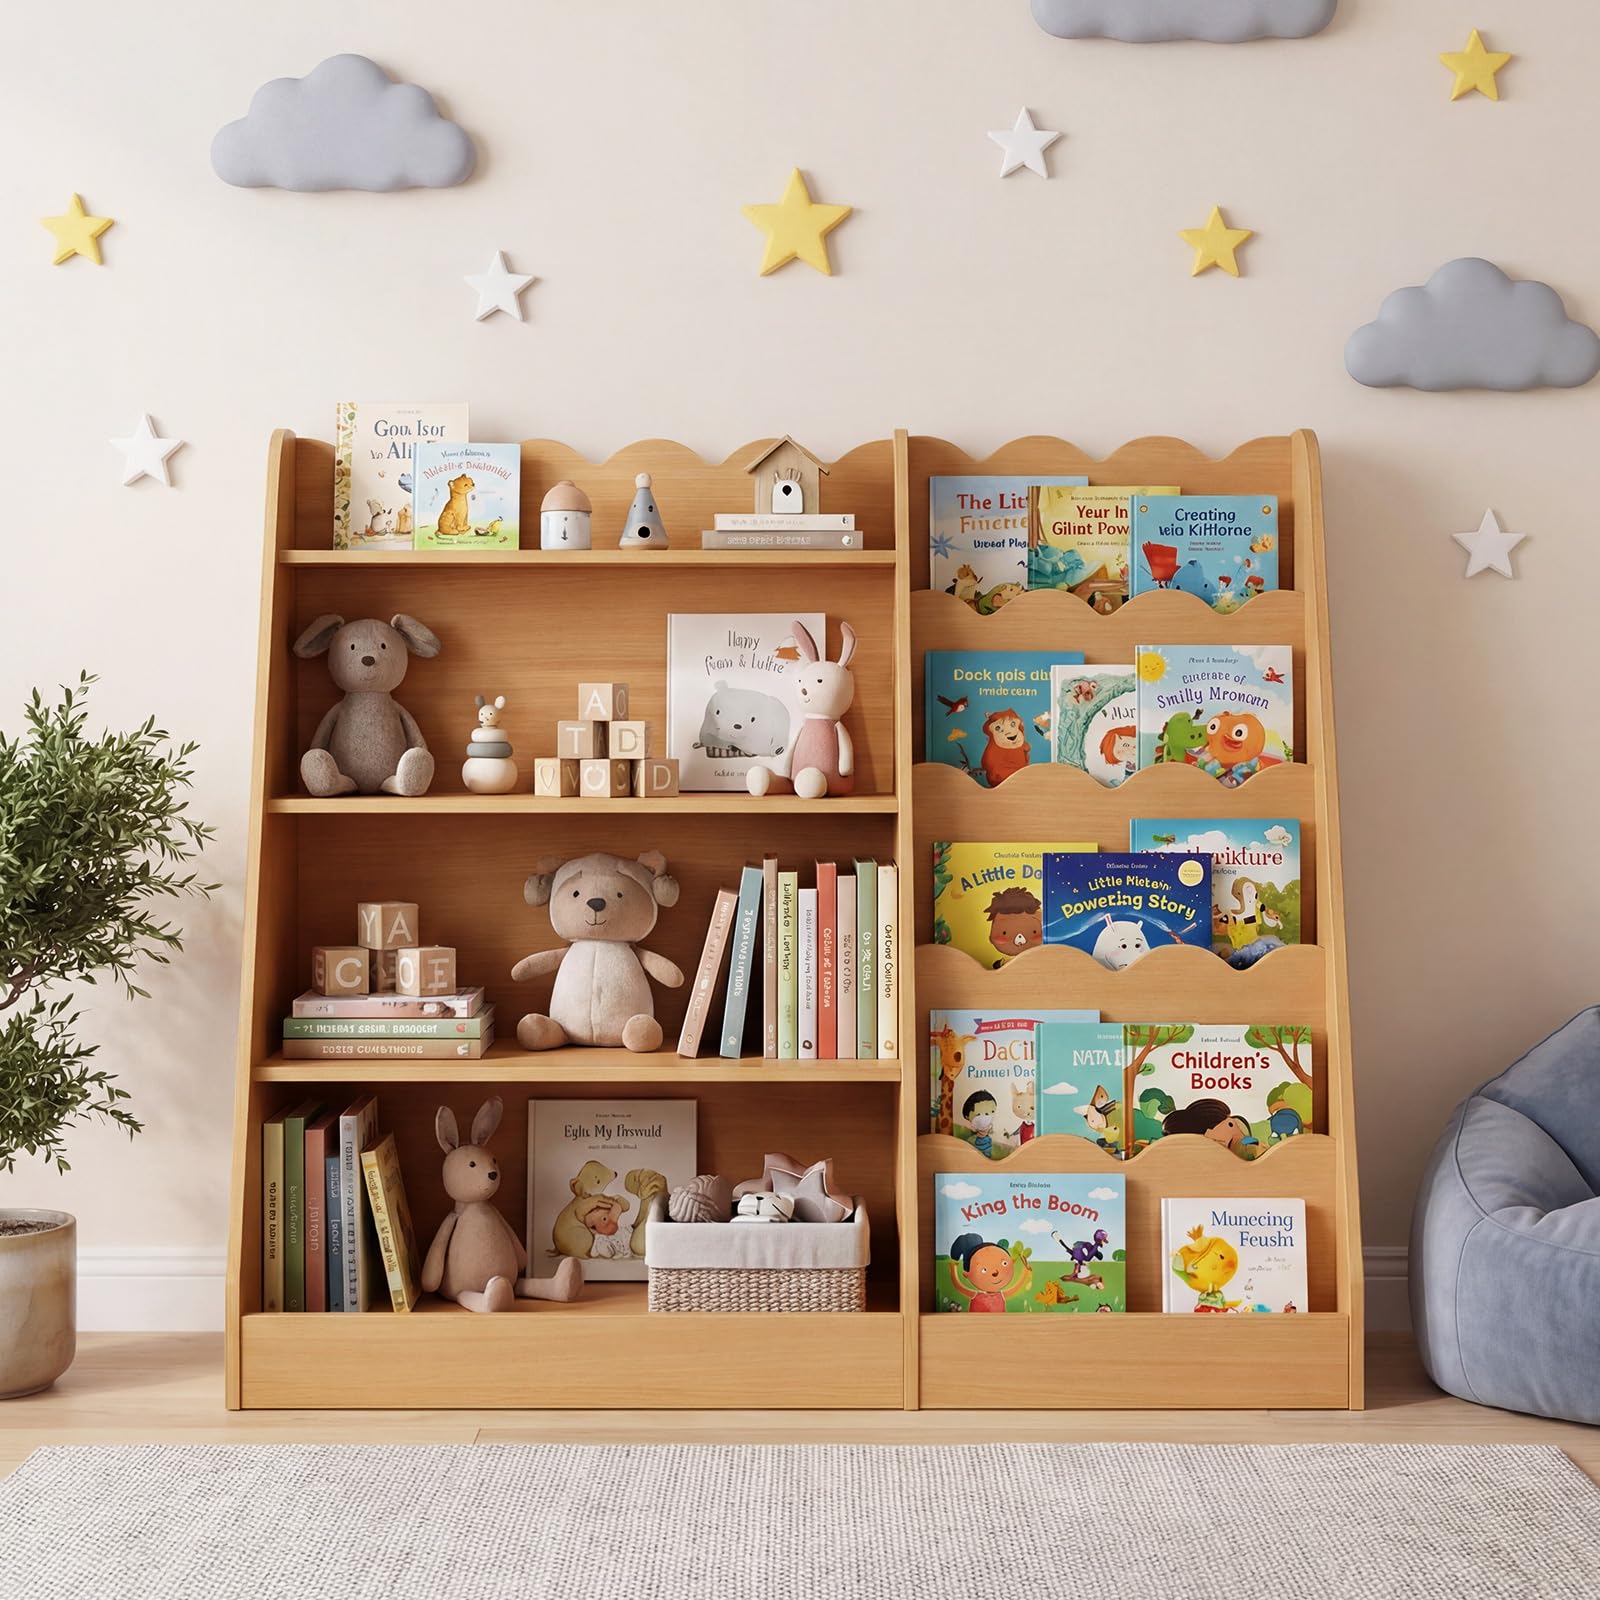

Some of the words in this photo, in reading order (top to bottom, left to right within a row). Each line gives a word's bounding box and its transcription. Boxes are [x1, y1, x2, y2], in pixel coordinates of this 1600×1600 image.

[956, 493, 992, 510] The
[999, 493, 1028, 510] Lit
[1175, 508, 1236, 524] Creating
[953, 668, 992, 681] Dock
[1234, 675, 1246, 685] of
[584, 688, 608, 716] A
[1157, 687, 1203, 709] Smilly
[566, 727, 587, 754] T
[618, 728, 639, 752] D
[653, 765, 672, 791] D
[960, 876, 974, 892] A
[972, 865, 1016, 887] Little
[1088, 875, 1123, 891] Little
[1148, 894, 1197, 920] Story
[361, 911, 376, 943] Y
[387, 911, 413, 944] A
[335, 957, 362, 988] C
[1073, 1049, 1112, 1066] NATA
[1171, 1051, 1270, 1070] Children's
[1190, 1073, 1252, 1090] Books
[594, 1124, 612, 1141] My
[960, 1198, 1008, 1222] King
[1012, 1193, 1042, 1210] the
[1047, 1194, 1100, 1222] Boom
